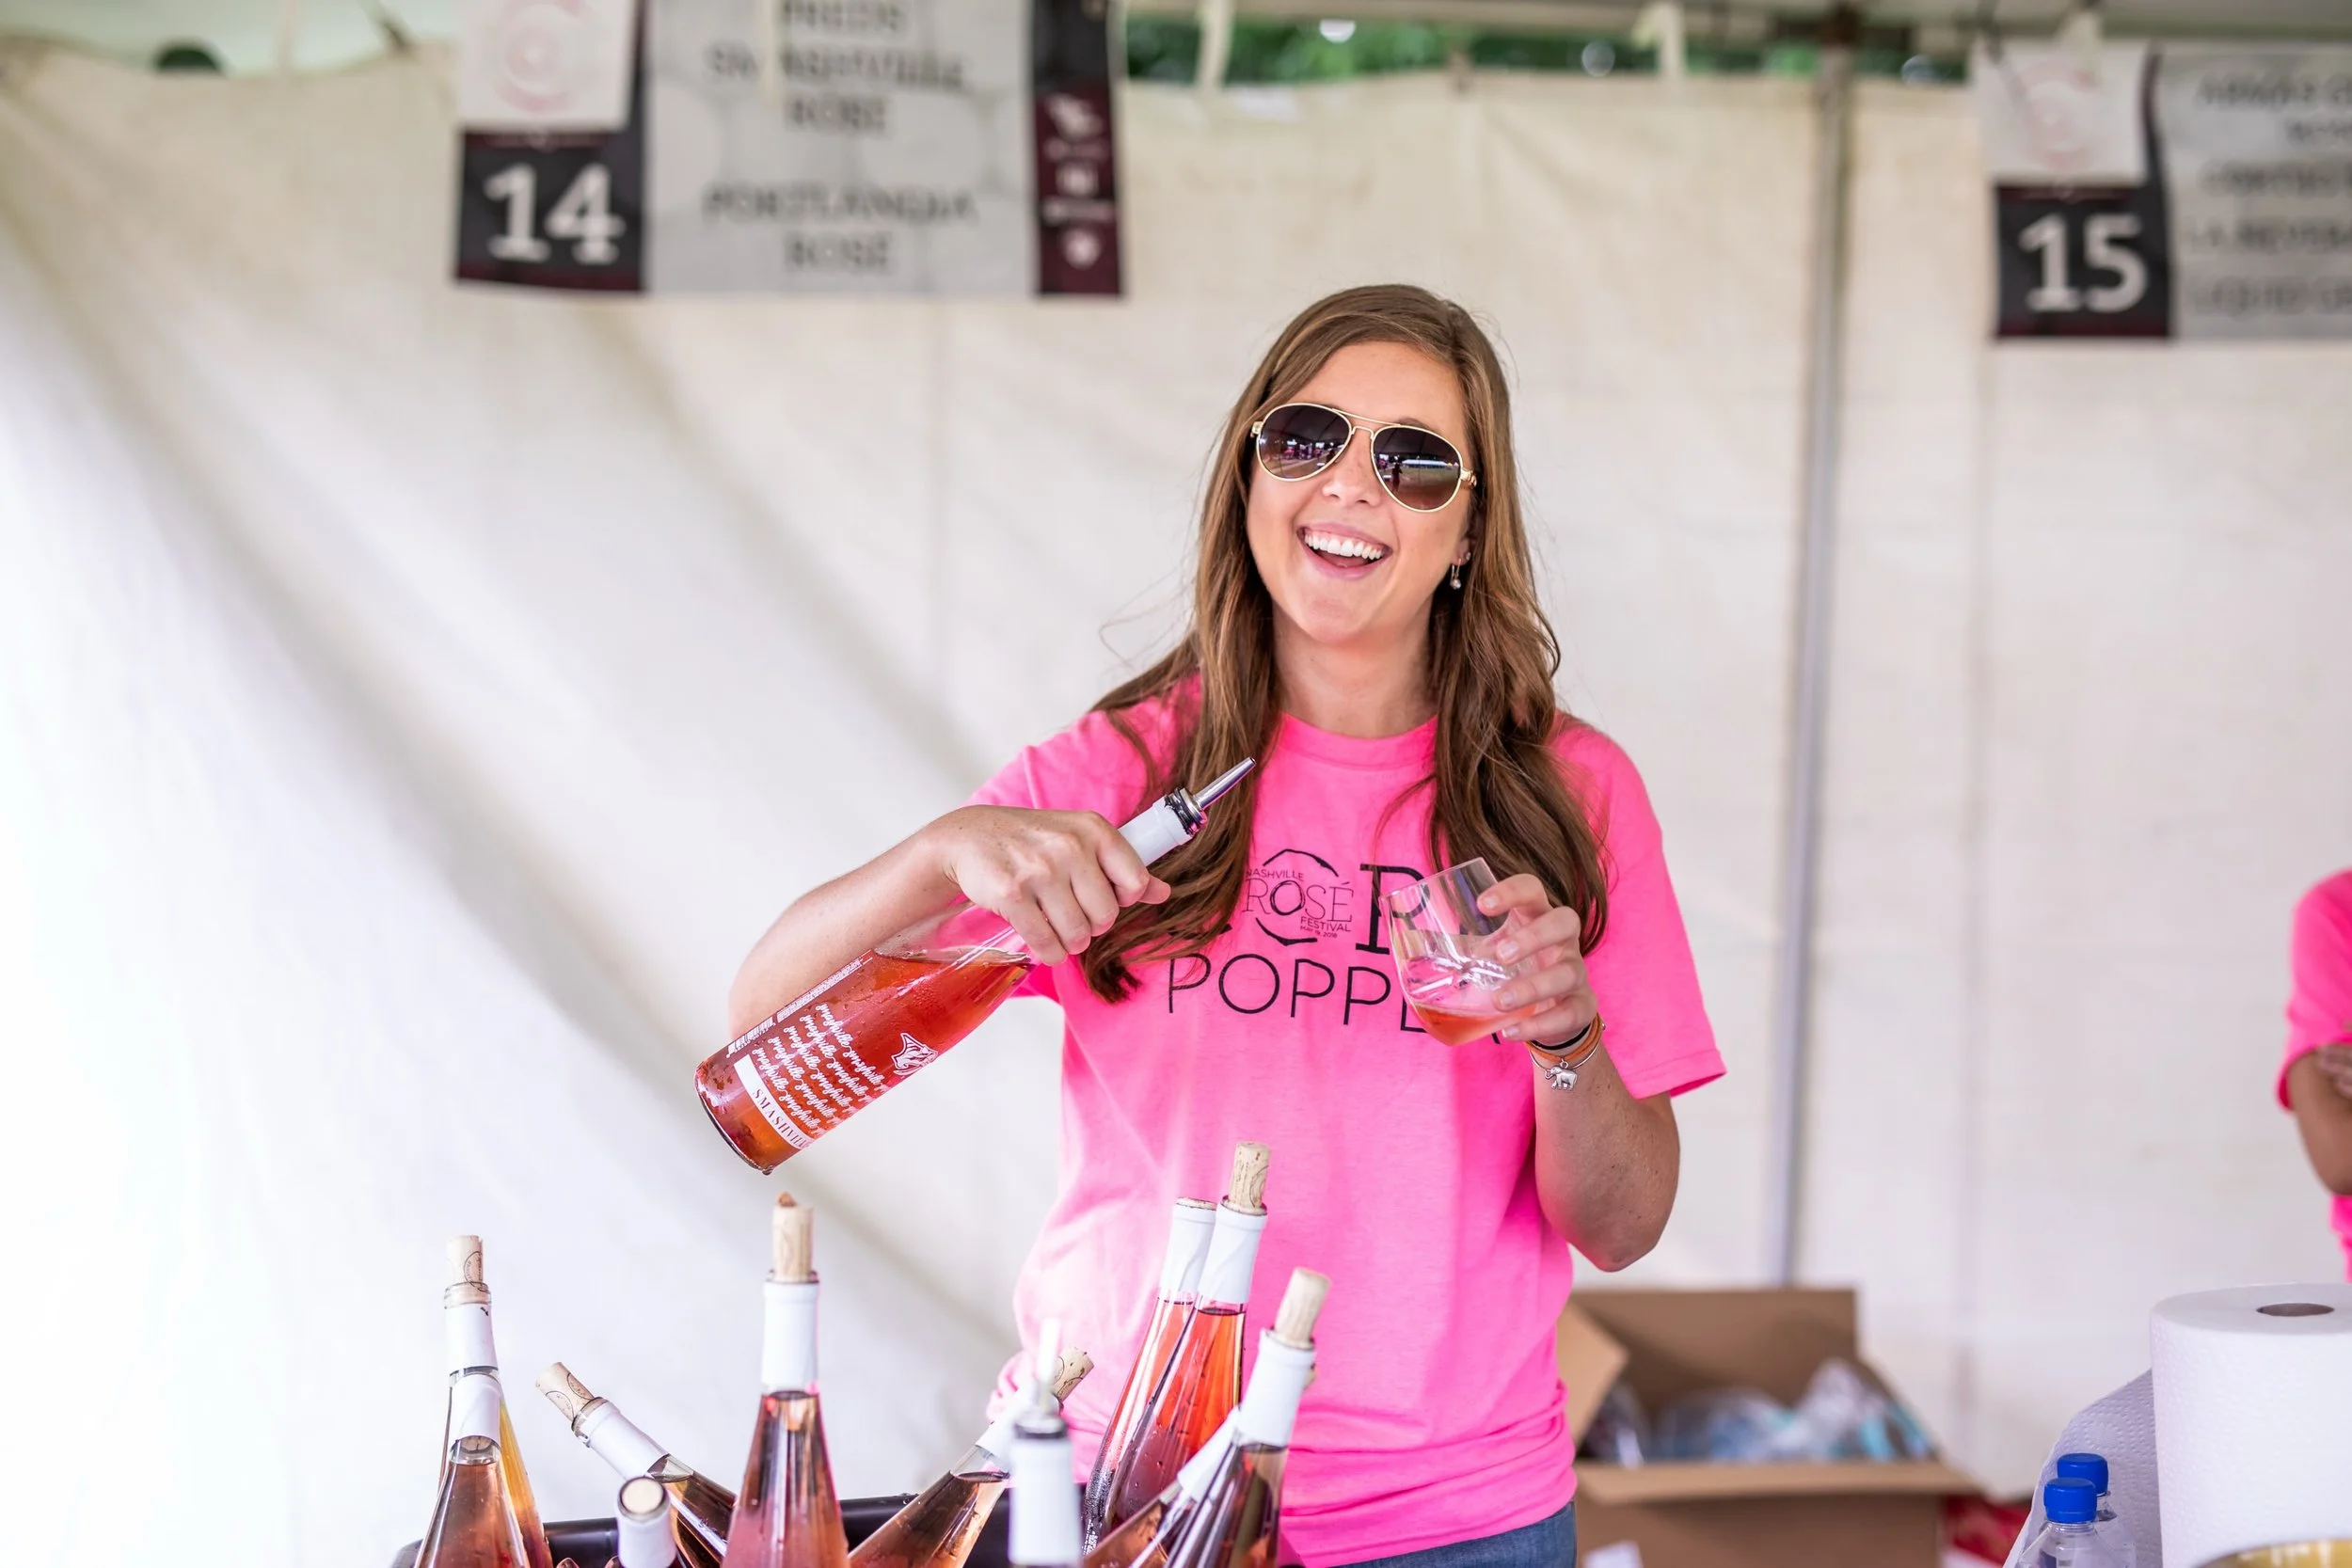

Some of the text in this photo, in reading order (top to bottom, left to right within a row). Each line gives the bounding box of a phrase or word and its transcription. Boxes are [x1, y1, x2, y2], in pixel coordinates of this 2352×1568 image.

[484, 163, 627, 264] 14
[2018, 212, 2148, 312] 15
[1246, 867, 1305, 882] NASHVILLE
[1242, 877, 1355, 923] ROSÉ
[1300, 915, 1352, 933] FESTIVAL
